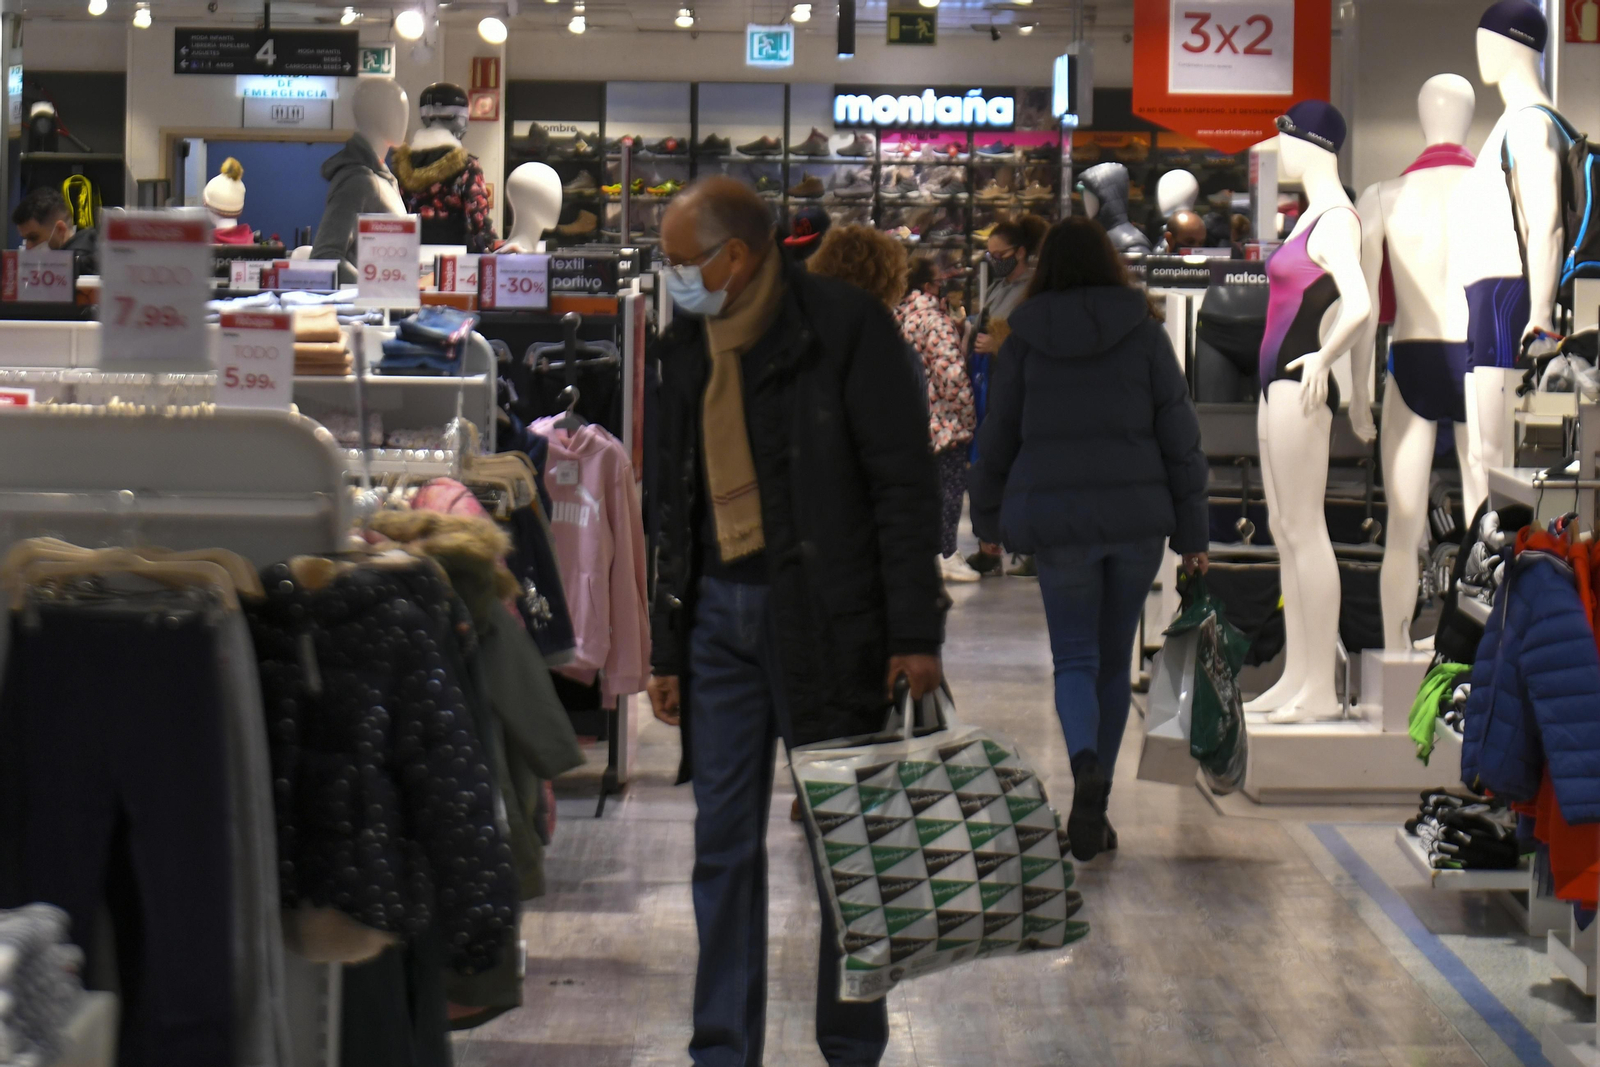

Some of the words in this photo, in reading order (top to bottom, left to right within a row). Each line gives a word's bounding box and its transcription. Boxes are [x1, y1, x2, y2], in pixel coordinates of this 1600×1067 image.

[1182, 11, 1274, 56] 3x2
[255, 38, 278, 67] 4
[277, 79, 294, 88] DE
[243, 88, 328, 98] EMERGENCIA
[833, 88, 1015, 126] montaña
[370, 245, 408, 258] TODO
[551, 257, 585, 270] textil
[618, 259, 632, 269] ar
[1152, 266, 1211, 277] complemen
[22, 270, 67, 287] -30%
[459, 273, 478, 286] -4
[552, 275, 603, 289] portivo
[500, 277, 545, 294] -30%
[233, 344, 279, 360] TODO
